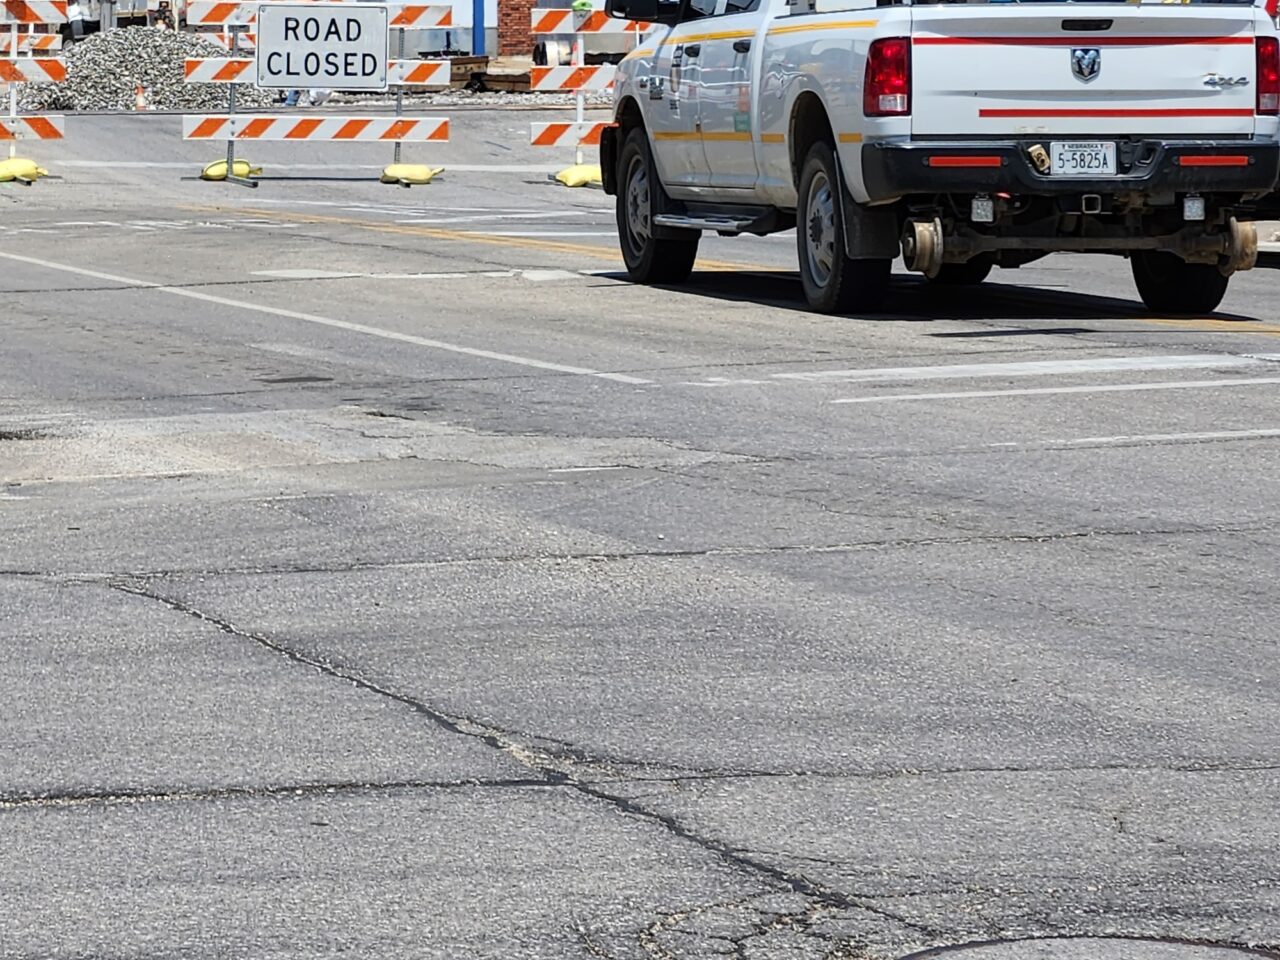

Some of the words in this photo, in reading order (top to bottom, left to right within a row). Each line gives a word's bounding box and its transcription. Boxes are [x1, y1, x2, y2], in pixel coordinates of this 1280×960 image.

[284, 17, 361, 41] ROAD
[267, 52, 377, 76] CLOSED
[1058, 152, 1108, 168] 5-5825A
